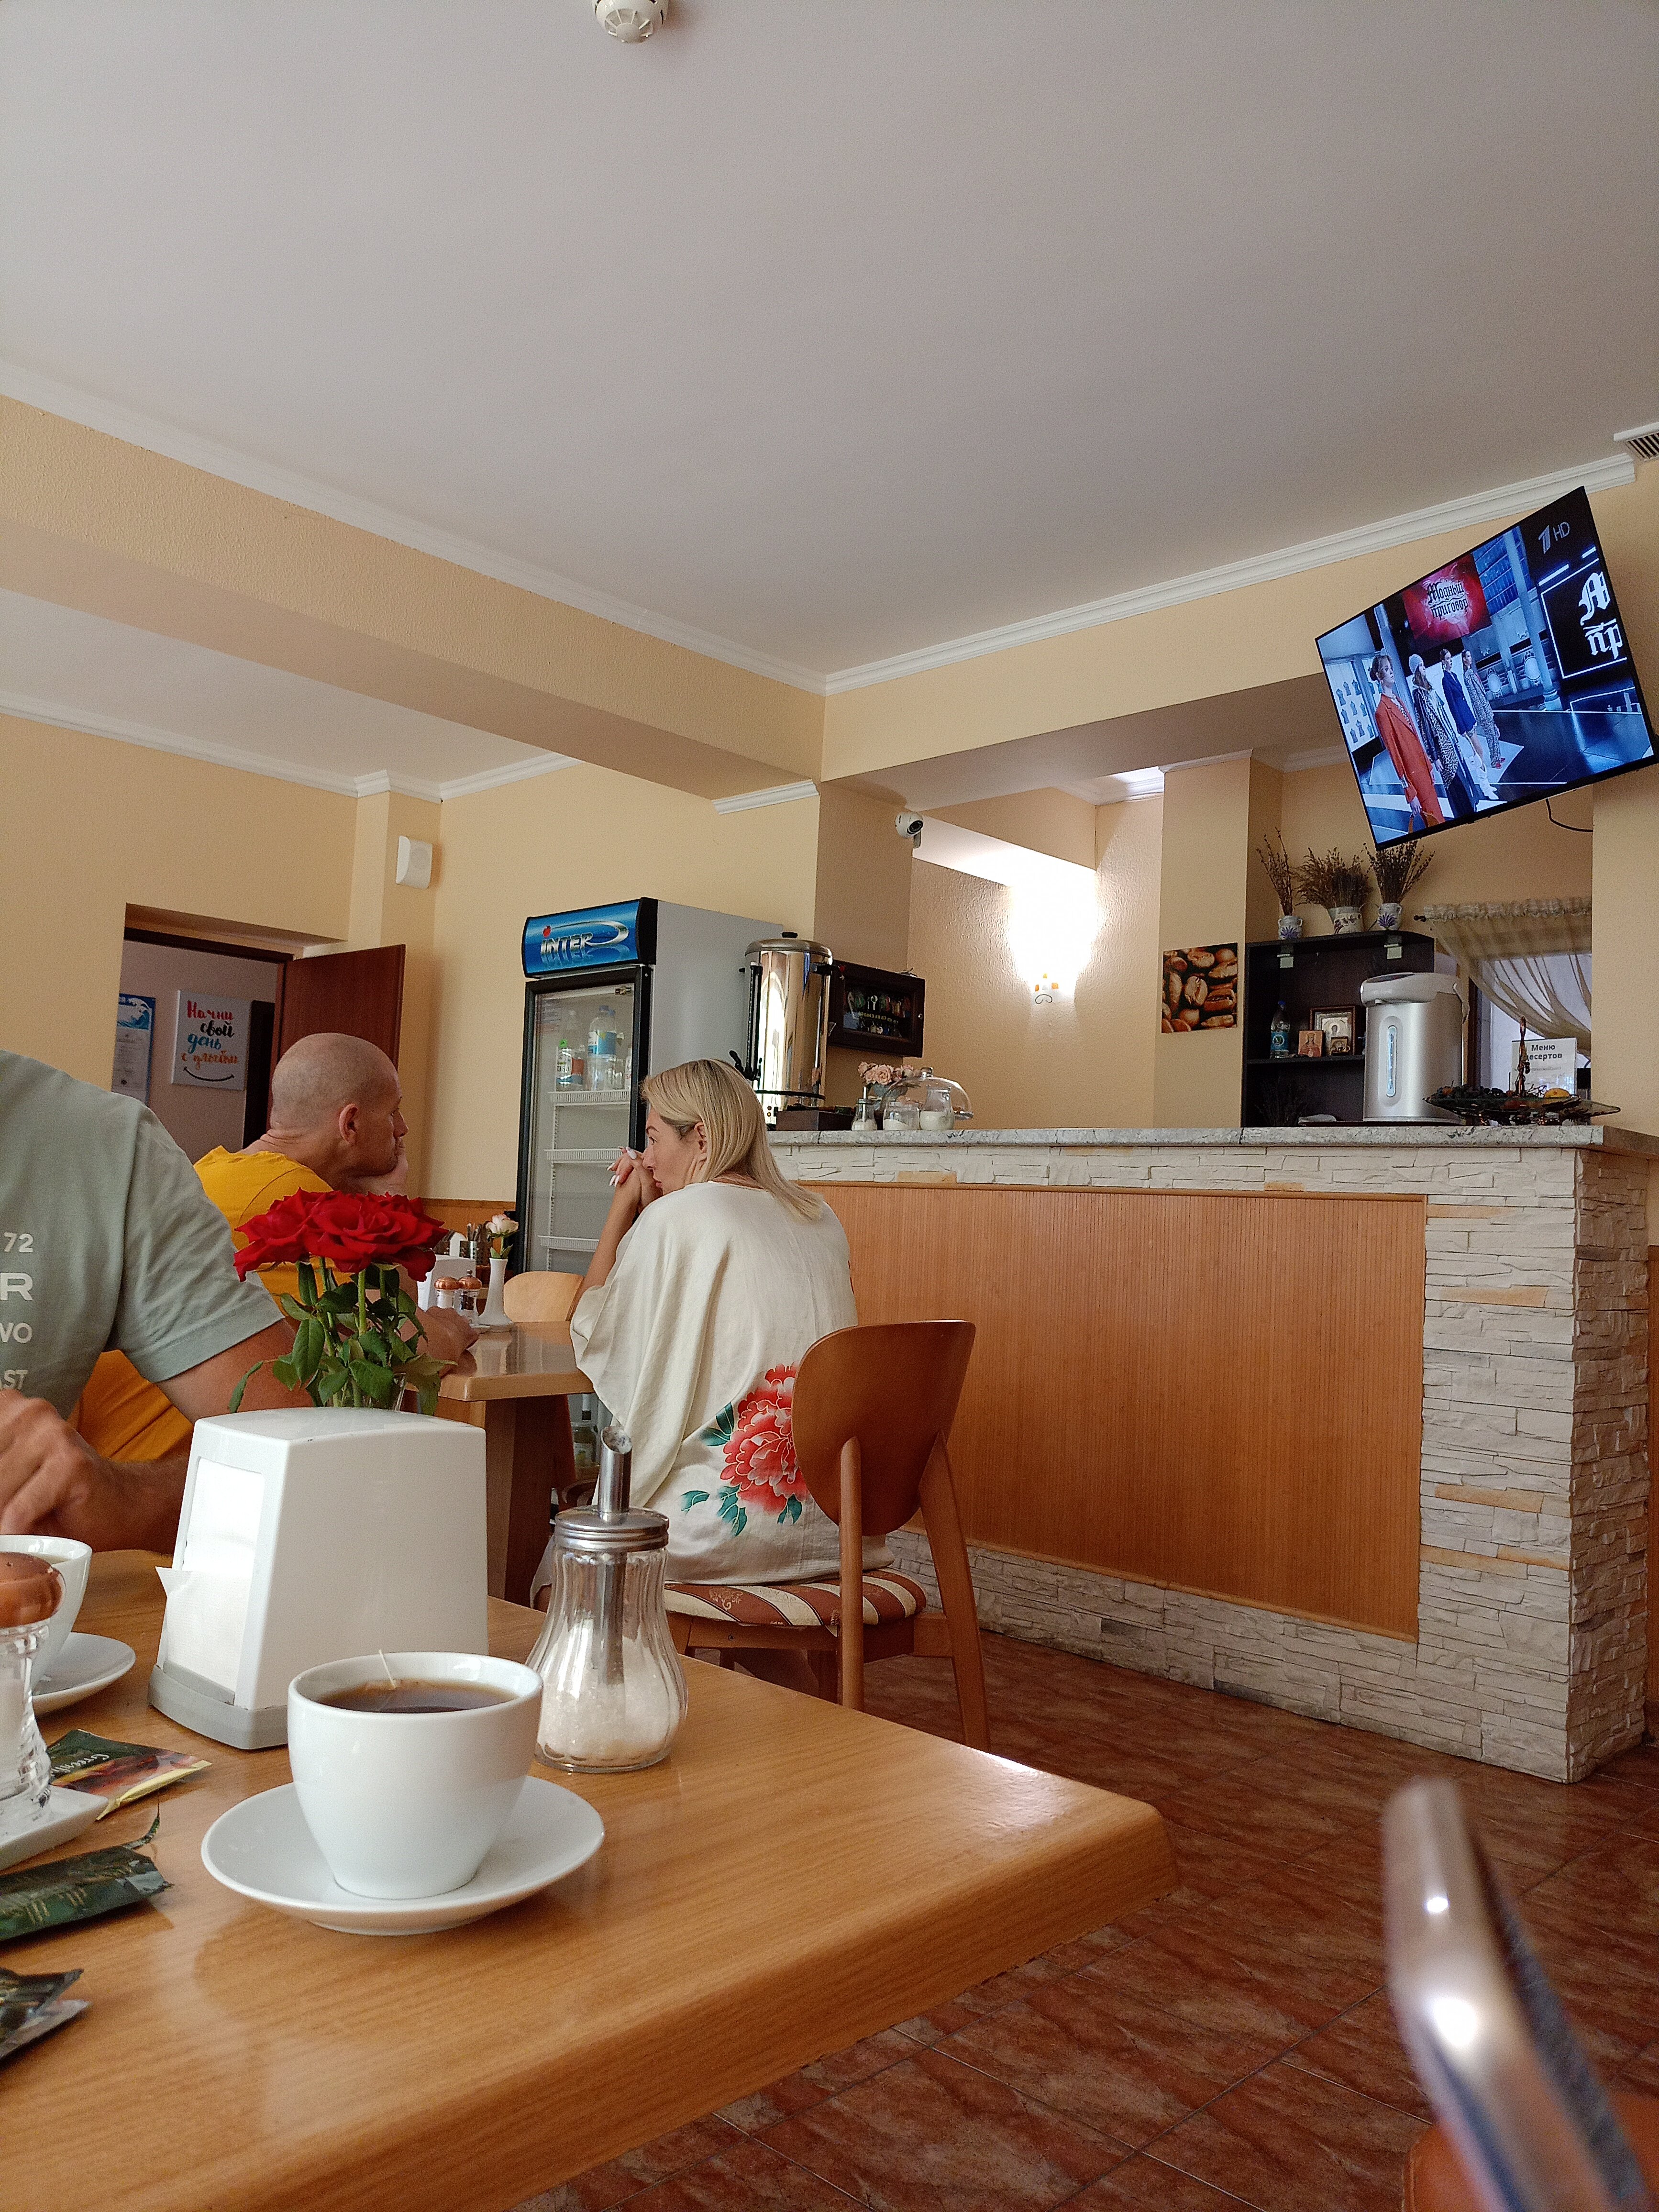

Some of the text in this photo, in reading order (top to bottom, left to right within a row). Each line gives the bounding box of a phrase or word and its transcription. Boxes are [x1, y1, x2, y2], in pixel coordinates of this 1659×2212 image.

[1553, 521, 1571, 542] HD
[1431, 598, 1468, 621] приговор
[540, 932, 594, 955] INTER
[187, 999, 234, 1020] Начни
[200, 1019, 235, 1038] свой
[187, 1033, 221, 1054] день
[4, 1232, 34, 1253] 72
[0, 1369, 29, 1390] ST
